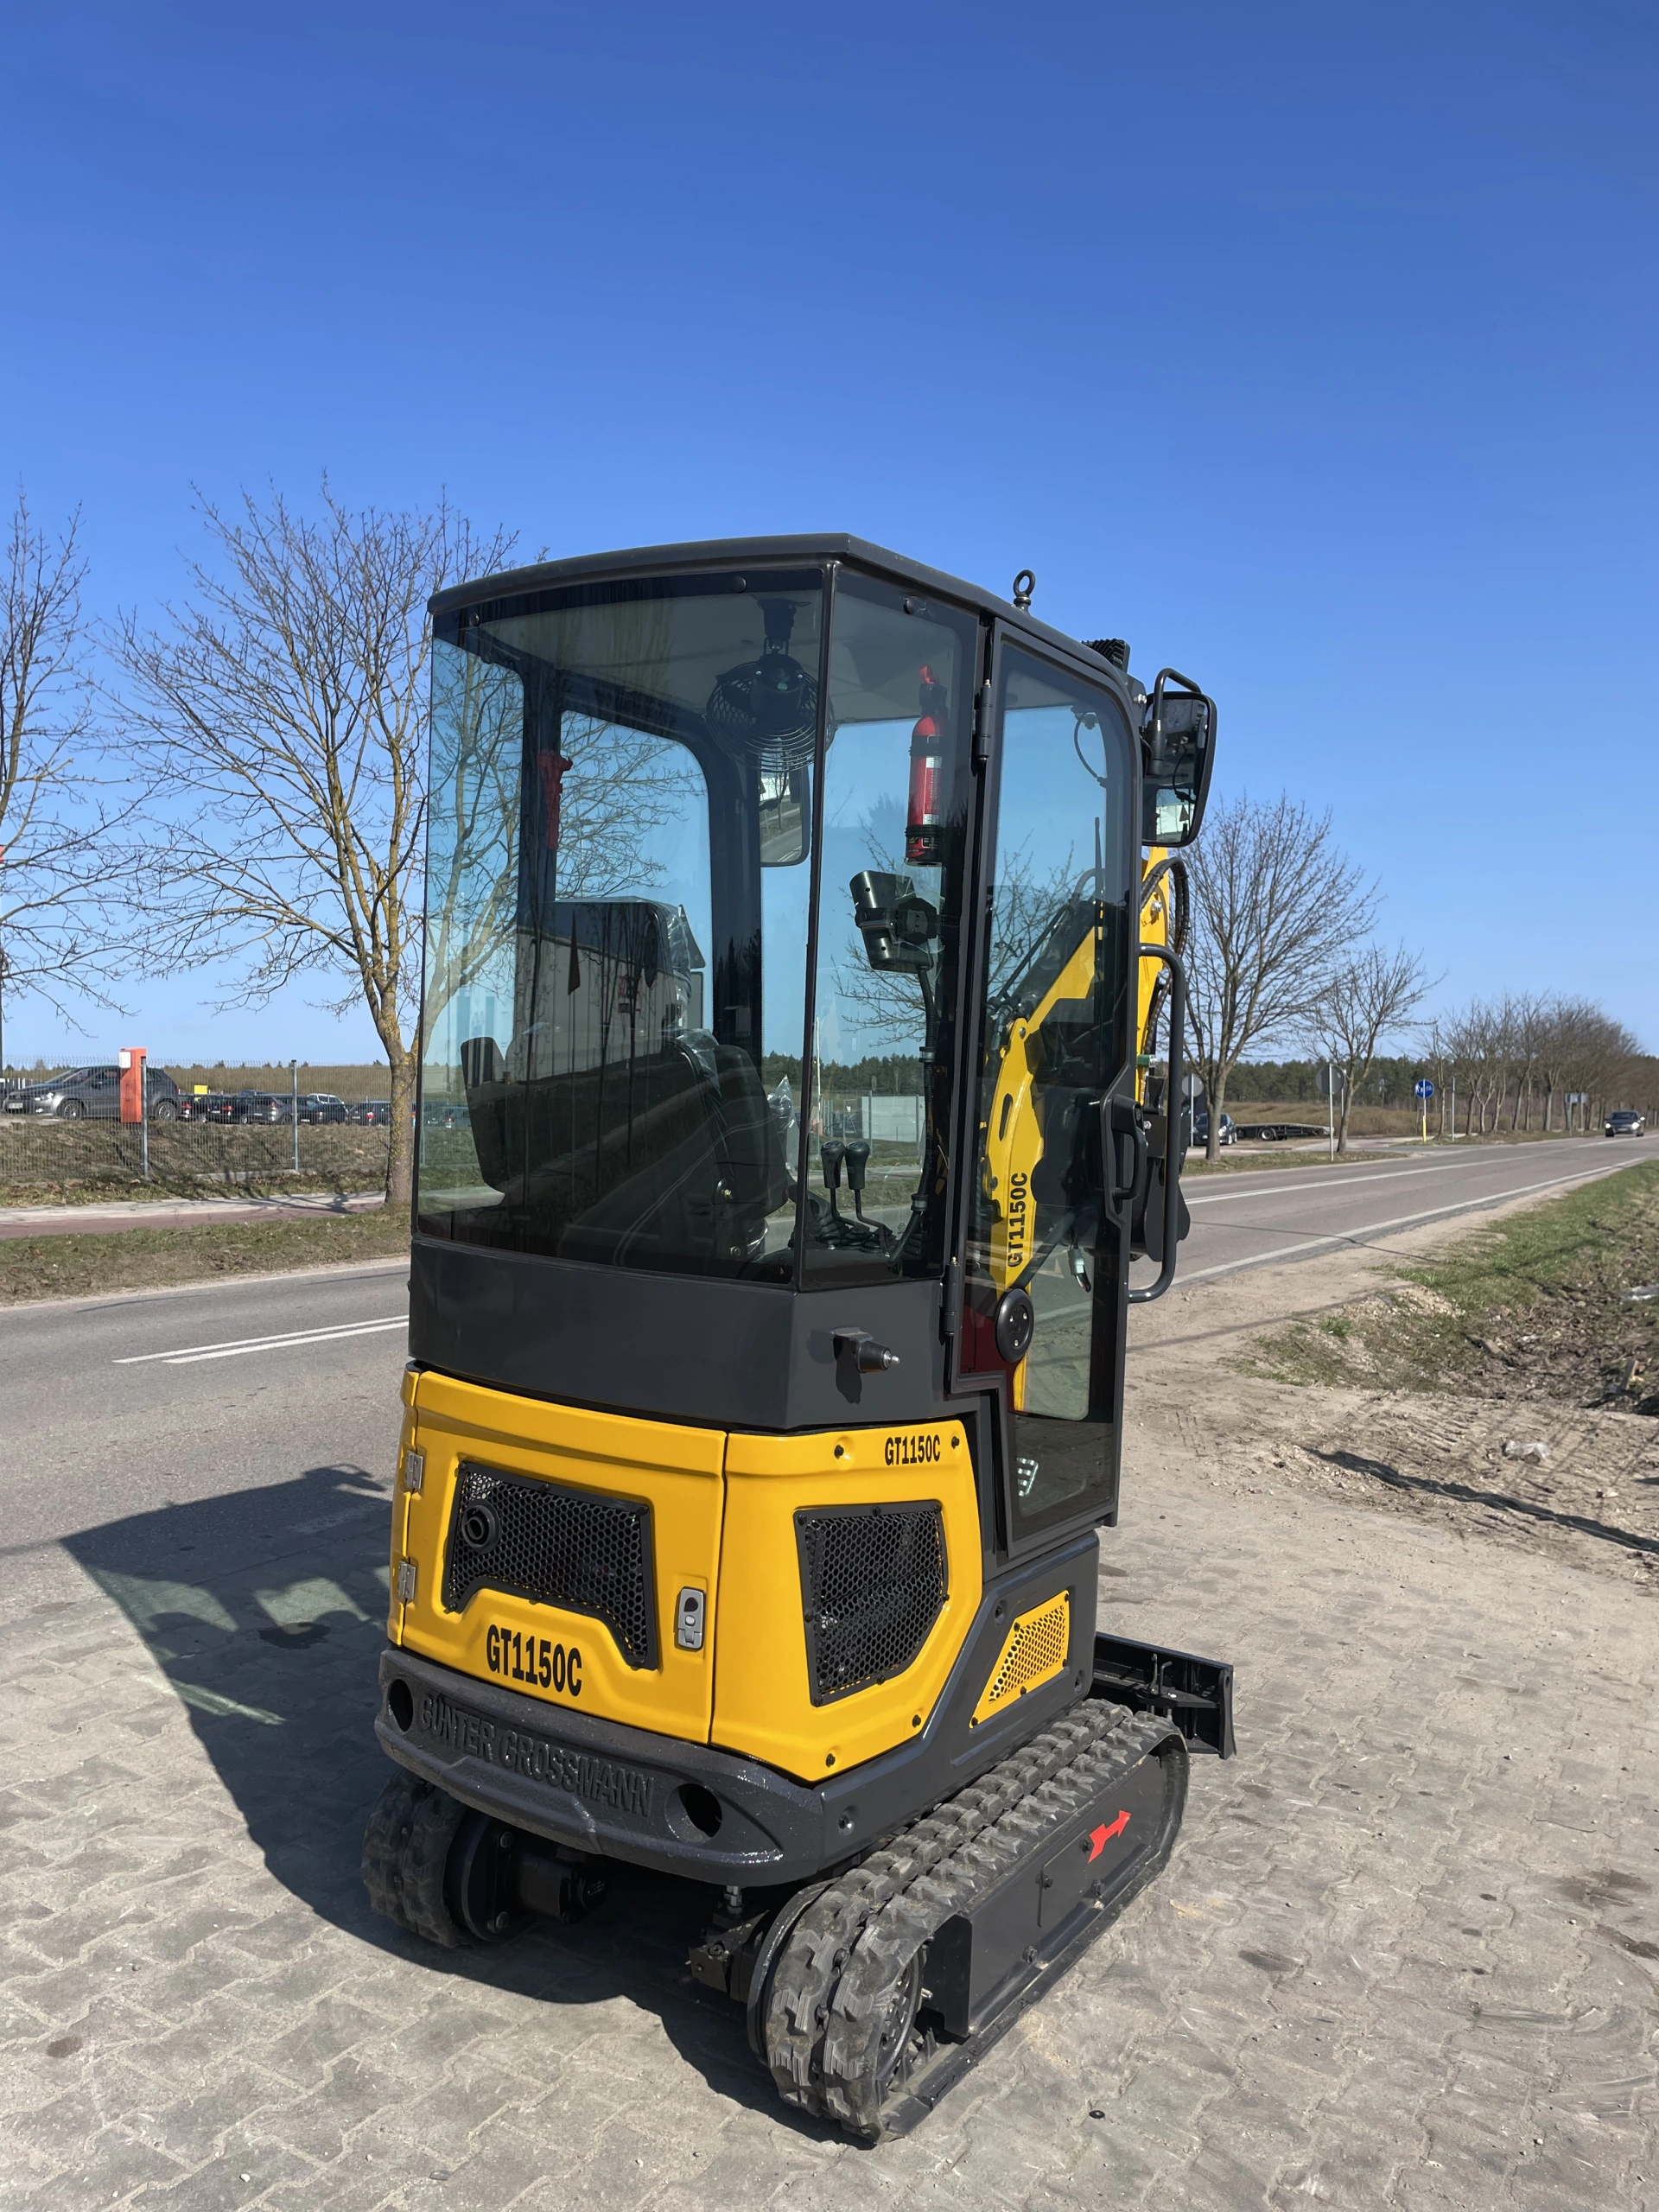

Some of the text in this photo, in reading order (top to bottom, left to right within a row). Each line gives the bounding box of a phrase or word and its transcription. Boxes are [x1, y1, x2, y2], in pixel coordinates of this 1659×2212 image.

[1007, 1172, 1027, 1267] GT1150C
[885, 1434, 940, 1465] GT1150C
[486, 1624, 582, 1697] GT1150C
[500, 1729, 654, 1816] GROSSMANN
